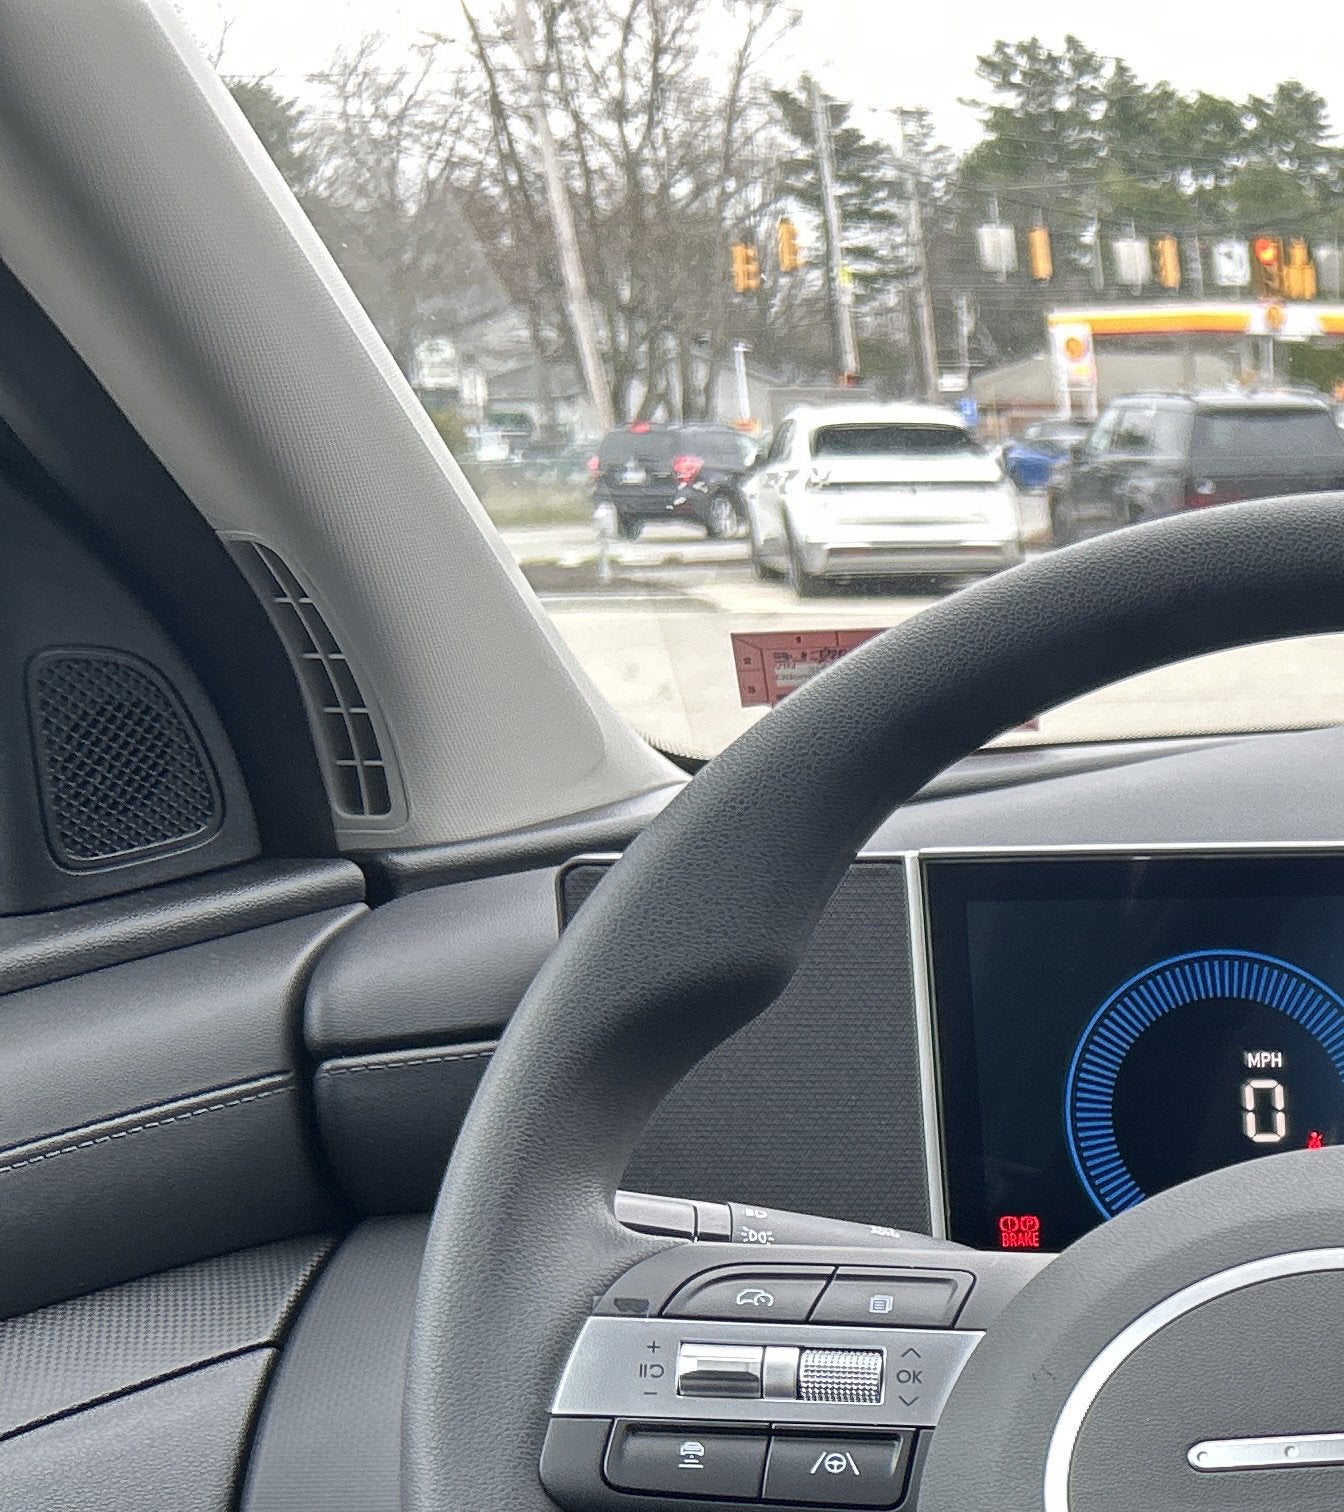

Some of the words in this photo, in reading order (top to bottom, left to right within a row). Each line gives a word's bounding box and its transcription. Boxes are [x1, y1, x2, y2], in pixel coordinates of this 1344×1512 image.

[1247, 1051, 1282, 1068] MPH
[1243, 1079, 1286, 1142] 0
[1002, 1233, 1040, 1247] BRAKE
[896, 1369, 923, 1385] OK
